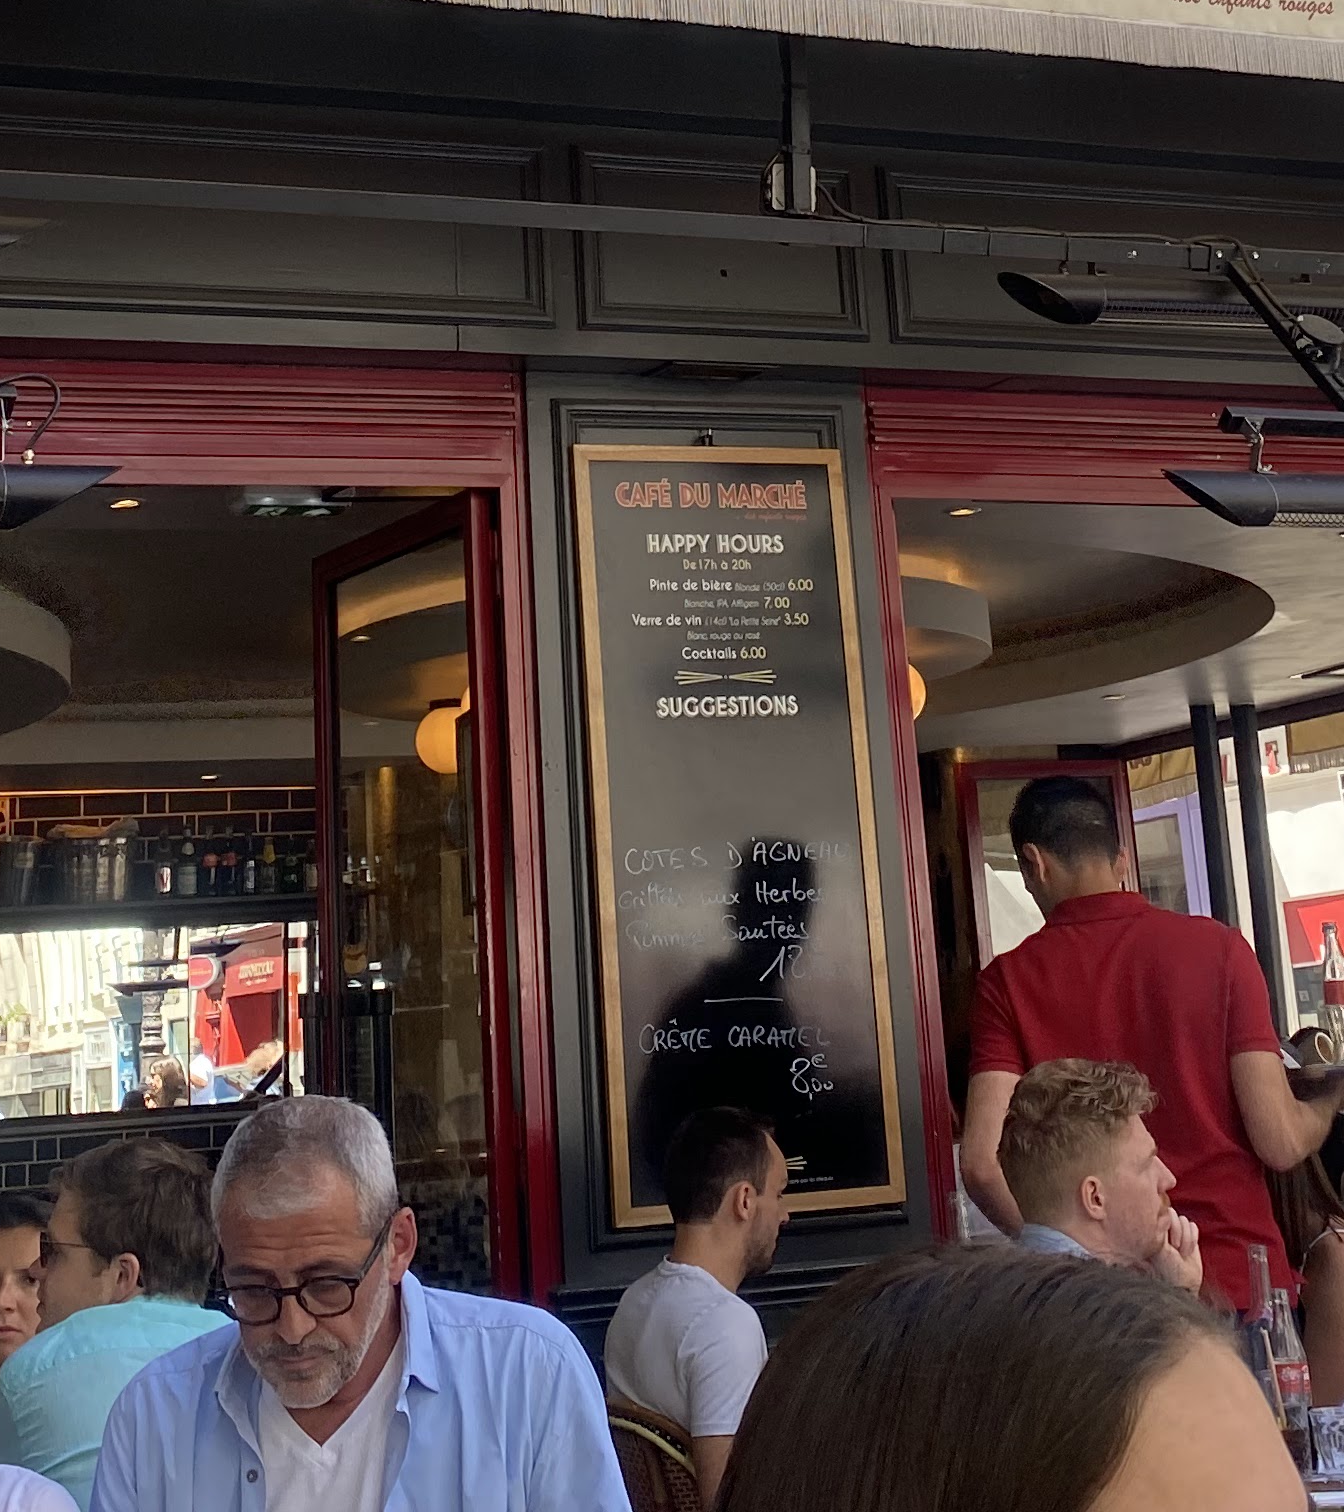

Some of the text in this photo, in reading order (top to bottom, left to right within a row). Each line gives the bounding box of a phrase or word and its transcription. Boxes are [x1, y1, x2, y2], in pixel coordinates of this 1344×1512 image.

[615, 478, 807, 510] CAFÉ DU MARCHÉ
[646, 533, 784, 554] HAPPY HOURS
[683, 558, 752, 571] De 17h à 20h
[649, 578, 679, 591] Pinte
[682, 578, 698, 591] de
[702, 578, 733, 591] bière
[787, 578, 814, 592] 6.00
[632, 613, 662, 626] Verre
[666, 613, 682, 626] de
[685, 614, 702, 626] vin
[783, 612, 809, 626] 3.50
[681, 645, 766, 660] Cocktails 6.00
[656, 695, 799, 719] SUGGESTIONS
[728, 1025, 830, 1049] CARAMEL
